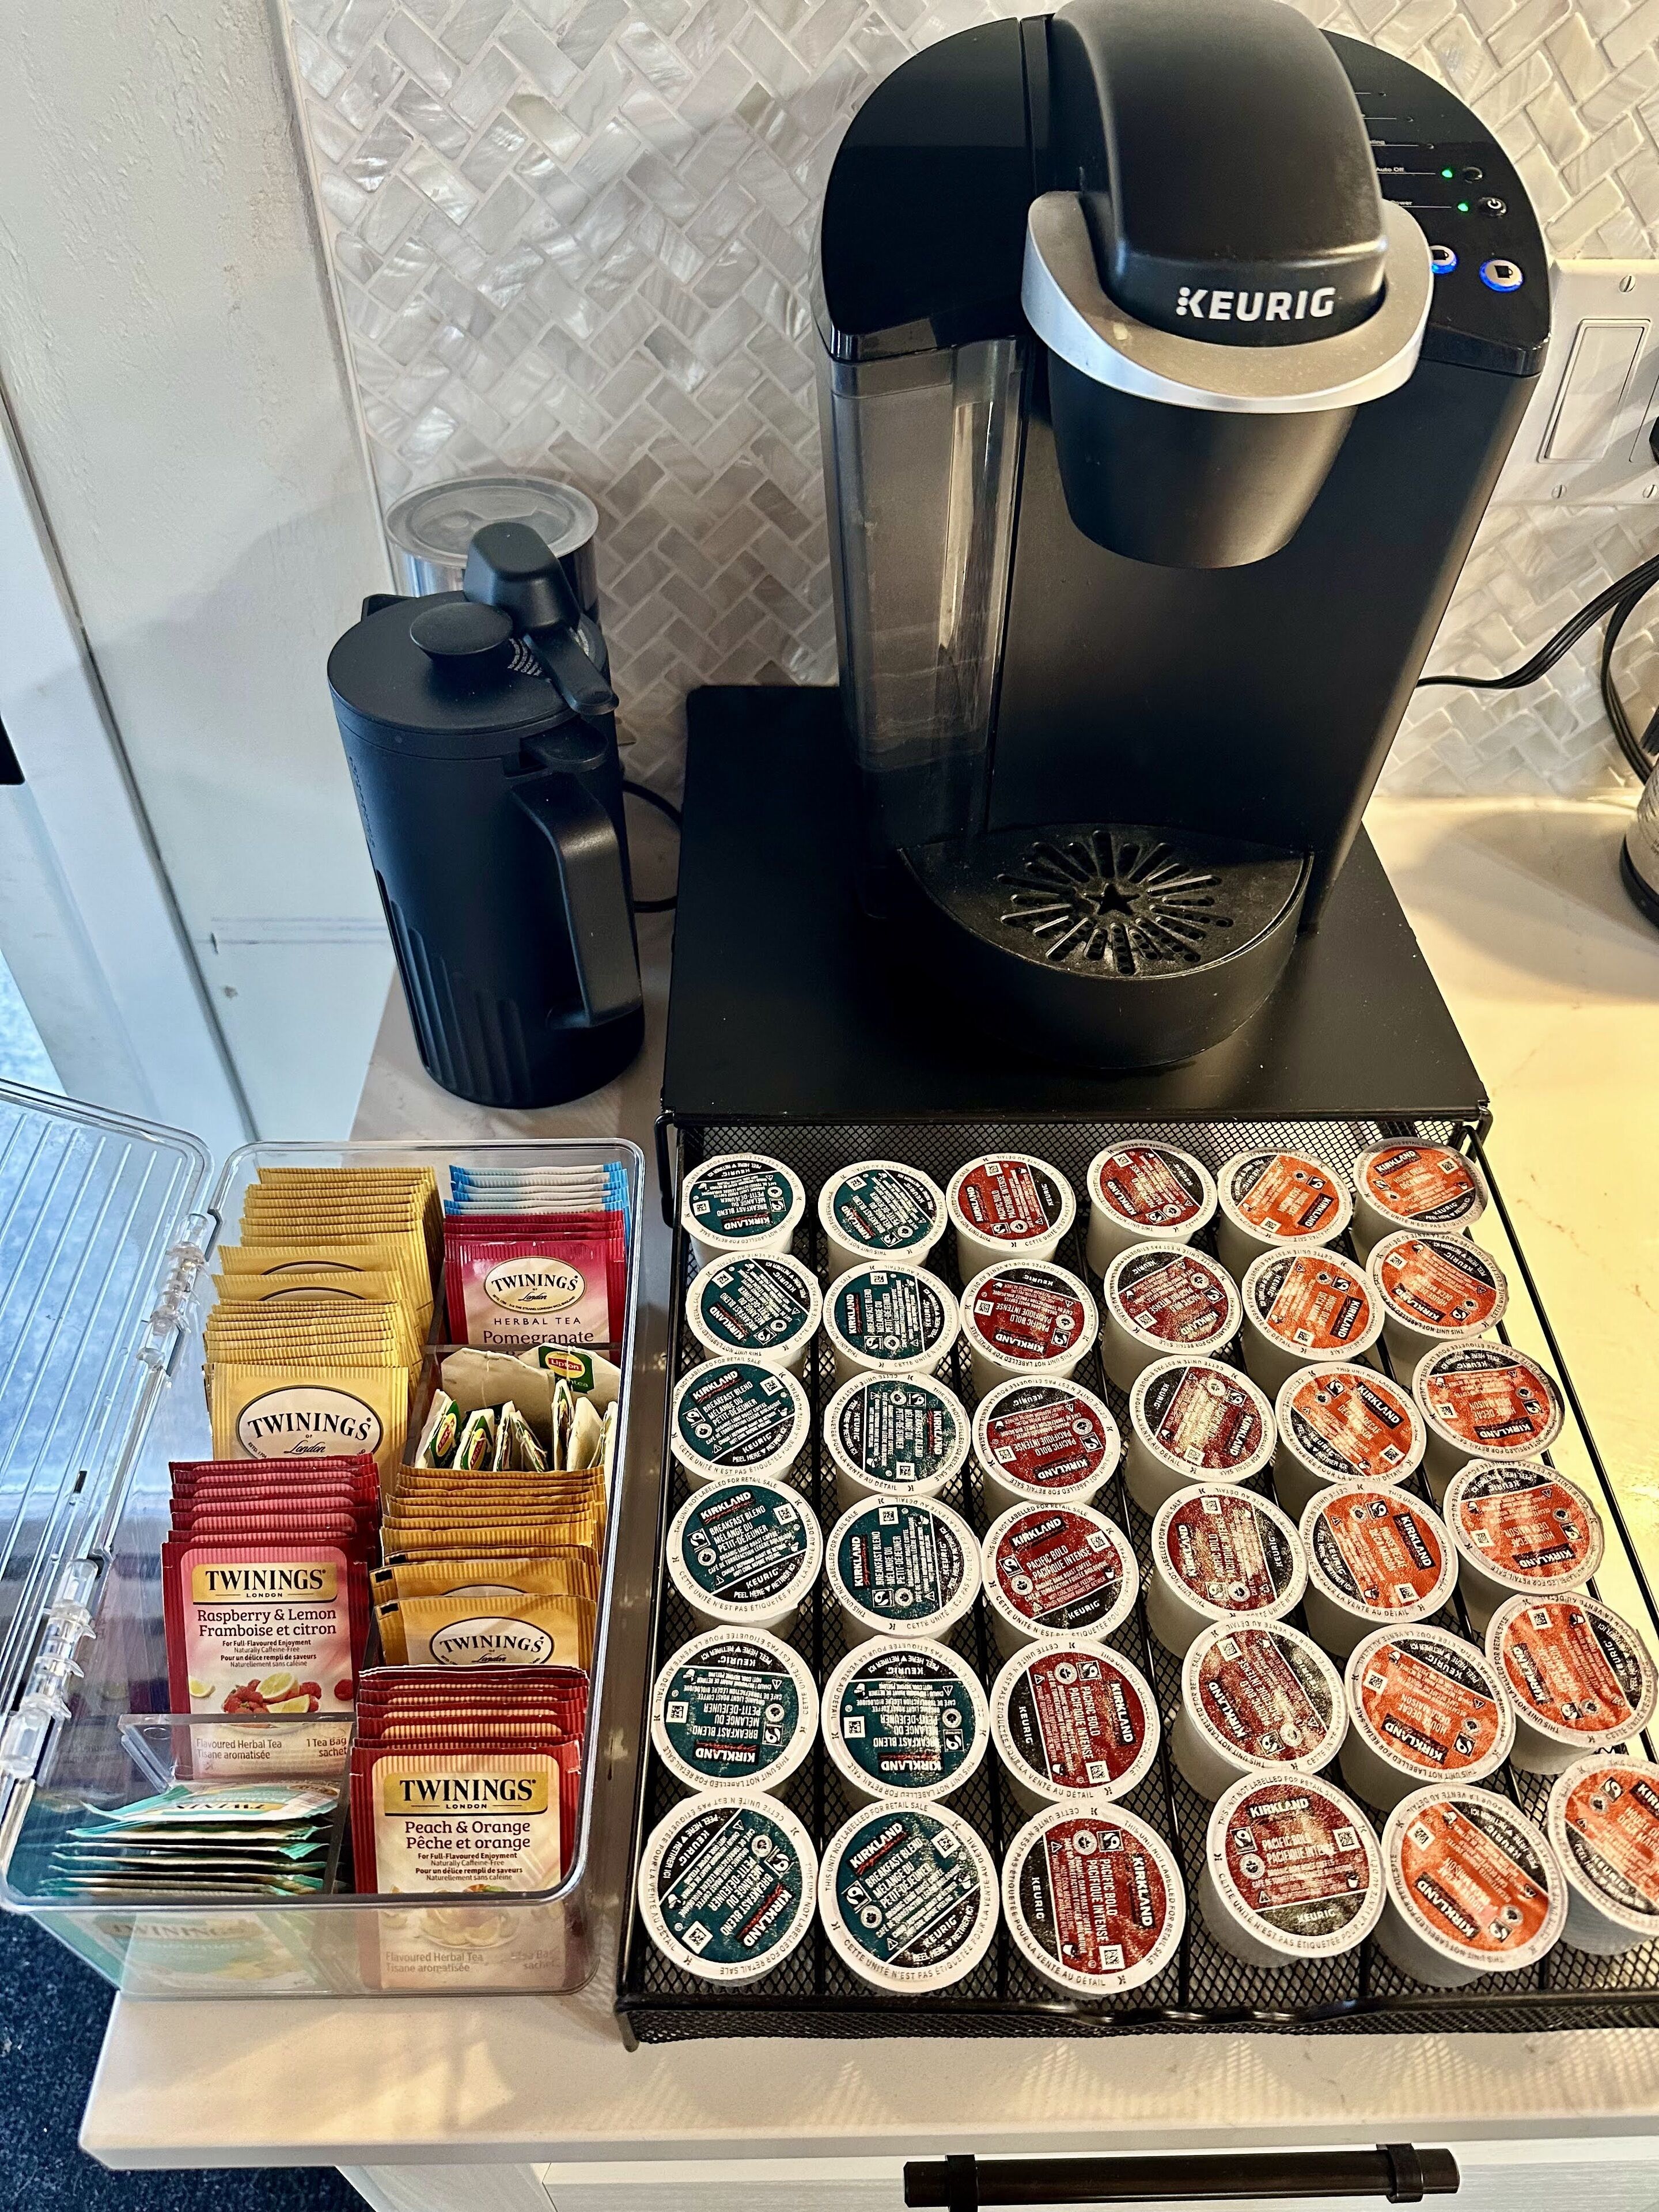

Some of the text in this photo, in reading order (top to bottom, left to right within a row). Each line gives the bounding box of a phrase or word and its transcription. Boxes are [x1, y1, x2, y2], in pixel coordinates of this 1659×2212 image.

[1176, 287, 1336, 321] KEURIG
[1376, 1150, 1416, 1173] KIRKLAND
[721, 1169, 752, 1178] KEURIG
[967, 1186, 983, 1222] KIRKLAND
[1041, 1185, 1054, 1207] KEURIG
[1108, 1181, 1138, 1217] KIRKLAND
[725, 1215, 771, 1229] KIRKLAND
[841, 1205, 873, 1240] KIRKLAND
[1305, 1197, 1330, 1229] KIRKLAND
[491, 1274, 578, 1291] TWININGS
[518, 1291, 547, 1301] London
[1393, 1287, 1440, 1321] KIRKLAND
[710, 1306, 744, 1342] KIRKLAND
[847, 1294, 857, 1334] KIRKLAND
[922, 1301, 931, 1328] KEURIG
[1339, 1300, 1359, 1339] KIRKLAND
[484, 1331, 594, 1344] Pomegranate
[996, 1334, 1045, 1352] KIRKLAND
[693, 1373, 738, 1400] KIRKLAND
[1357, 1385, 1400, 1424] KIRKLAND
[248, 1413, 370, 1440] TWININGS
[934, 1411, 942, 1455] KIRKLAND
[1229, 1416, 1252, 1455] KIRKLAND
[1479, 1424, 1531, 1439] KIRKLAND
[284, 1440, 325, 1454] London
[742, 1433, 771, 1452] KEURIG
[1037, 1459, 1087, 1480] KIRKLAND
[700, 1493, 751, 1519] KIRKLAND
[709, 1505, 766, 1536] BREAKFAST BLEND
[745, 1522, 753, 1531] DU
[1010, 1517, 1060, 1546] KIRKLAND
[1402, 1516, 1430, 1566] KIRKLAND
[852, 1537, 862, 1586] KIRKLAND
[940, 1542, 950, 1576] KEURIG
[1520, 1548, 1574, 1569] KIRKLAND
[206, 1570, 323, 1590] TWININGS
[745, 1569, 778, 1589] KEURIG
[198, 1609, 336, 1624] Raspberry & Lemon
[1066, 1600, 1099, 1619] KEURIG
[199, 1623, 336, 1636] Framboise et citron
[440, 1635, 543, 1653] TWININGS
[701, 1646, 772, 1665] PEEL HERE RETIRER ICI
[472, 1653, 506, 1663] London
[719, 1658, 755, 1666] KEURIG
[1512, 1645, 1546, 1704] KIRKLAND
[714, 1715, 724, 1724] DU
[1110, 1683, 1132, 1743] KIRKLAND
[1209, 1682, 1247, 1738] KIRKLAND
[692, 1726, 757, 1739] BREAKFAST BLEND
[1020, 1707, 1033, 1743] KEURIG
[196, 1739, 282, 1748] Flavoured Herbal Tea
[197, 1749, 270, 1759] Tisane aromatisée
[313, 1738, 327, 1747] Tea
[330, 1738, 346, 1746] Bag
[319, 1747, 347, 1757] sachet
[1384, 1721, 1445, 1764] KIRKLAND
[695, 1748, 755, 1762] KIRKLAND
[881, 1759, 942, 1770] KIRKLAND
[400, 1779, 532, 1801] TWININGS
[1250, 1798, 1308, 1817] KIRKLAND
[406, 1821, 531, 1835] Peach & Orange
[827, 1854, 835, 1874] UNIT
[834, 1838, 844, 1854] NOT
[842, 1813, 869, 1840] LABELLED
[870, 1805, 884, 1816] FOR
[885, 1802, 909, 1810] RETAIL
[911, 1802, 929, 1812] SALE
[407, 1836, 531, 1851] Pêche et orange
[678, 1829, 707, 1865] KEURIG
[849, 1824, 904, 1869] KIRKLAND
[1032, 1876, 1044, 1919] KEURIG
[1100, 1859, 1118, 1915] PACIFIC BOLD
[1132, 1856, 1153, 1927] KIRKLAND
[1087, 1859, 1109, 1942] PACIFIQUE INTENSE
[1418, 1880, 1475, 1937] KIRKLAND
[744, 1889, 791, 1945] KIRKLAND
[922, 1918, 956, 1948] KEURIG
[387, 1952, 483, 1961] Flavoured Herbal Tea
[387, 1964, 415, 1972] Tisane
